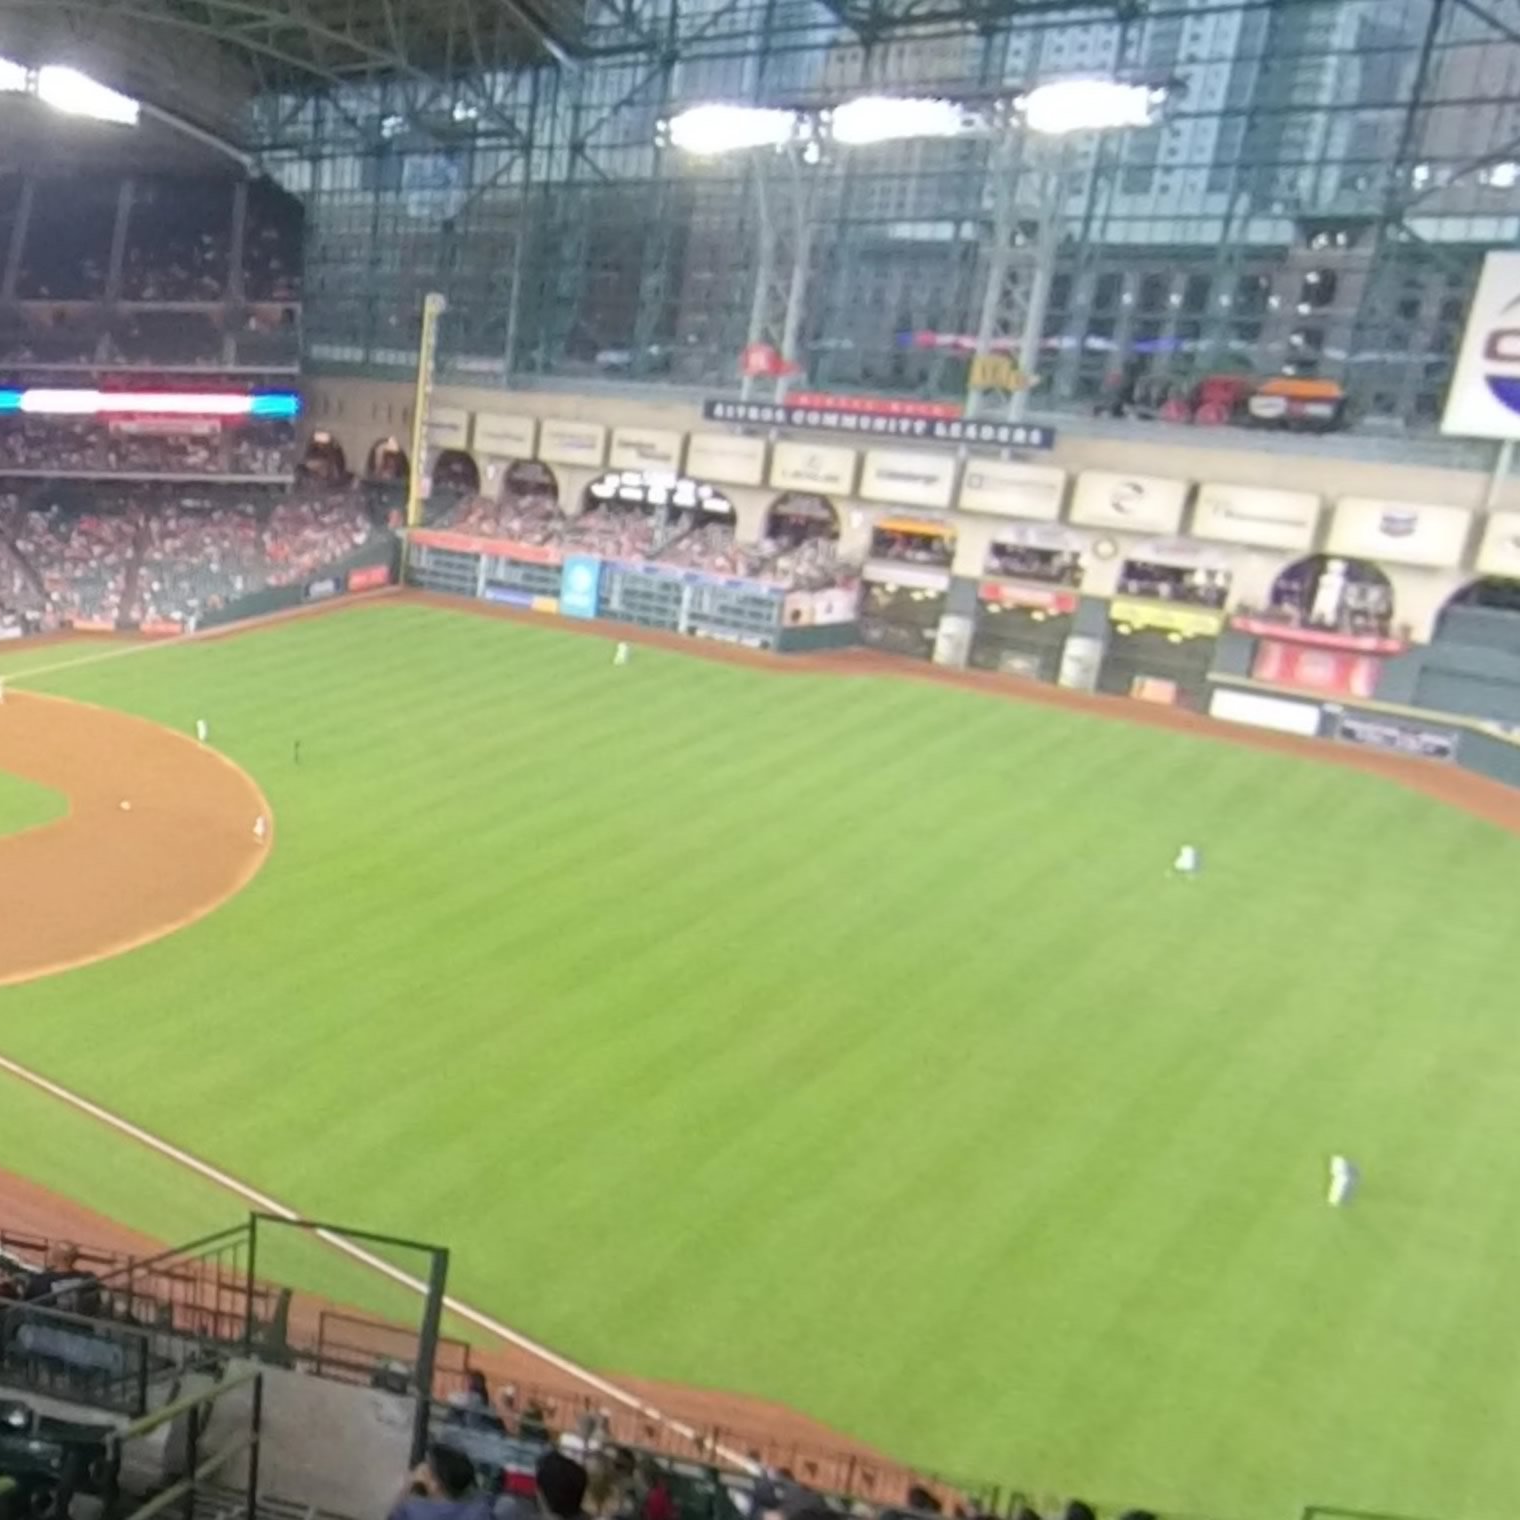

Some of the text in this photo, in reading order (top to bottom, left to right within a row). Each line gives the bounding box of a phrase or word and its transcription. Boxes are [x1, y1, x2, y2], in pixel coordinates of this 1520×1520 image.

[713, 402, 786, 424] ASTROS
[791, 408, 927, 434] COMMUNITY
[933, 420, 1042, 446] LEADERS
